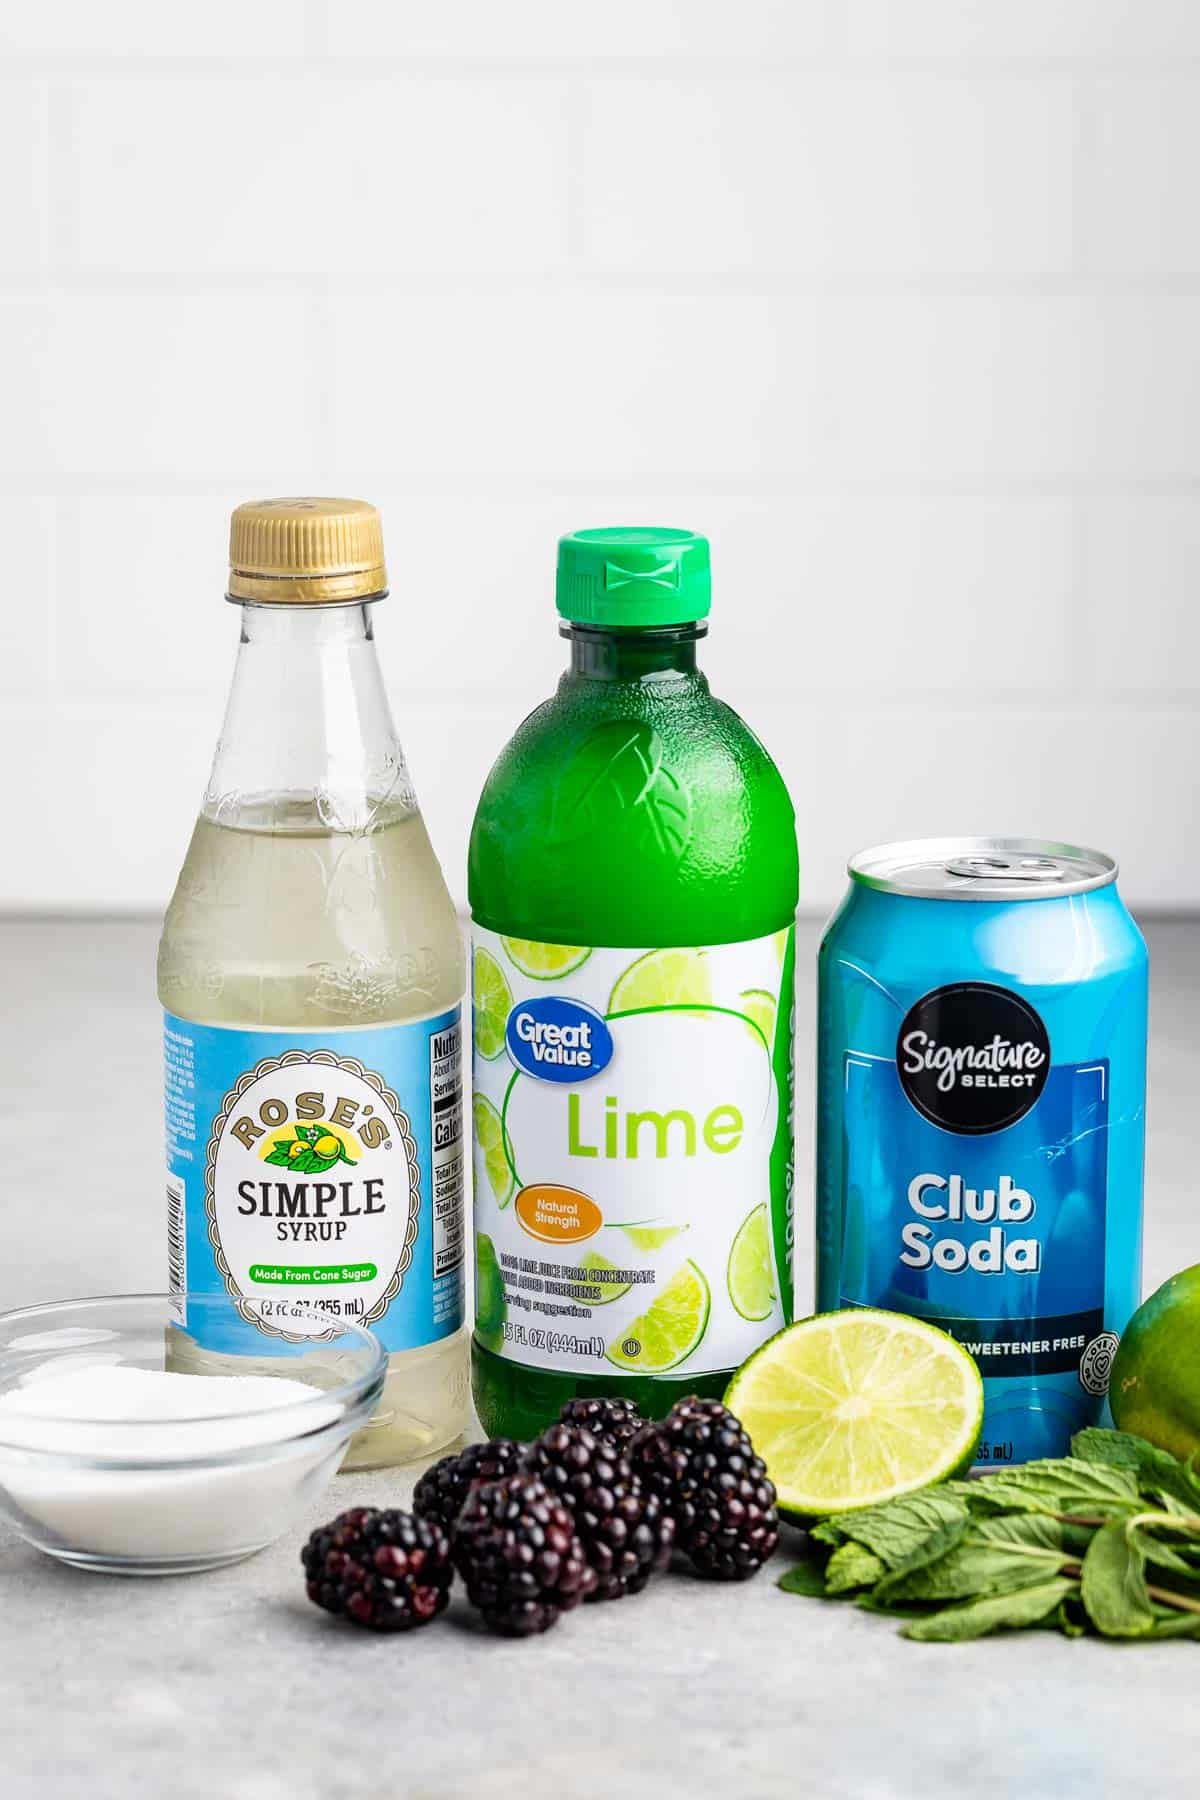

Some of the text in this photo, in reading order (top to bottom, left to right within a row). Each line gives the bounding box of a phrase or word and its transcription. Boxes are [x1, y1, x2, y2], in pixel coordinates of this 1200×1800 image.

[516, 1013, 591, 1049] Great
[531, 1043, 592, 1067] Value
[902, 1030, 1046, 1092] Signature
[961, 1074, 1036, 1088] SELECT
[230, 1092, 391, 1151] ROSE'S
[567, 1093, 744, 1159] Lime
[237, 1178, 386, 1218] SIMPLE
[537, 1198, 578, 1215] Natural
[907, 1172, 1036, 1224] Club
[277, 1221, 347, 1241] SYRUP
[535, 1211, 580, 1229] Strength
[900, 1222, 1041, 1275] Soda
[255, 1267, 371, 1281] Made From Cane Sugar
[519, 1257, 538, 1273] LIME
[539, 1261, 561, 1278] JUICE
[562, 1265, 587, 1281] FROM
[589, 1269, 656, 1284] CONCENTRATE
[518, 1275, 544, 1293] ADDED
[544, 1280, 601, 1300] INGREDIENTS
[345, 1297, 365, 1316] mL)
[533, 1301, 592, 1318] suggestion
[501, 1320, 605, 1358] 15 FL OZ (444mL)
[959, 1335, 1086, 1356] SWEETENER FREE
[976, 1440, 1014, 1461] 55 mL)
